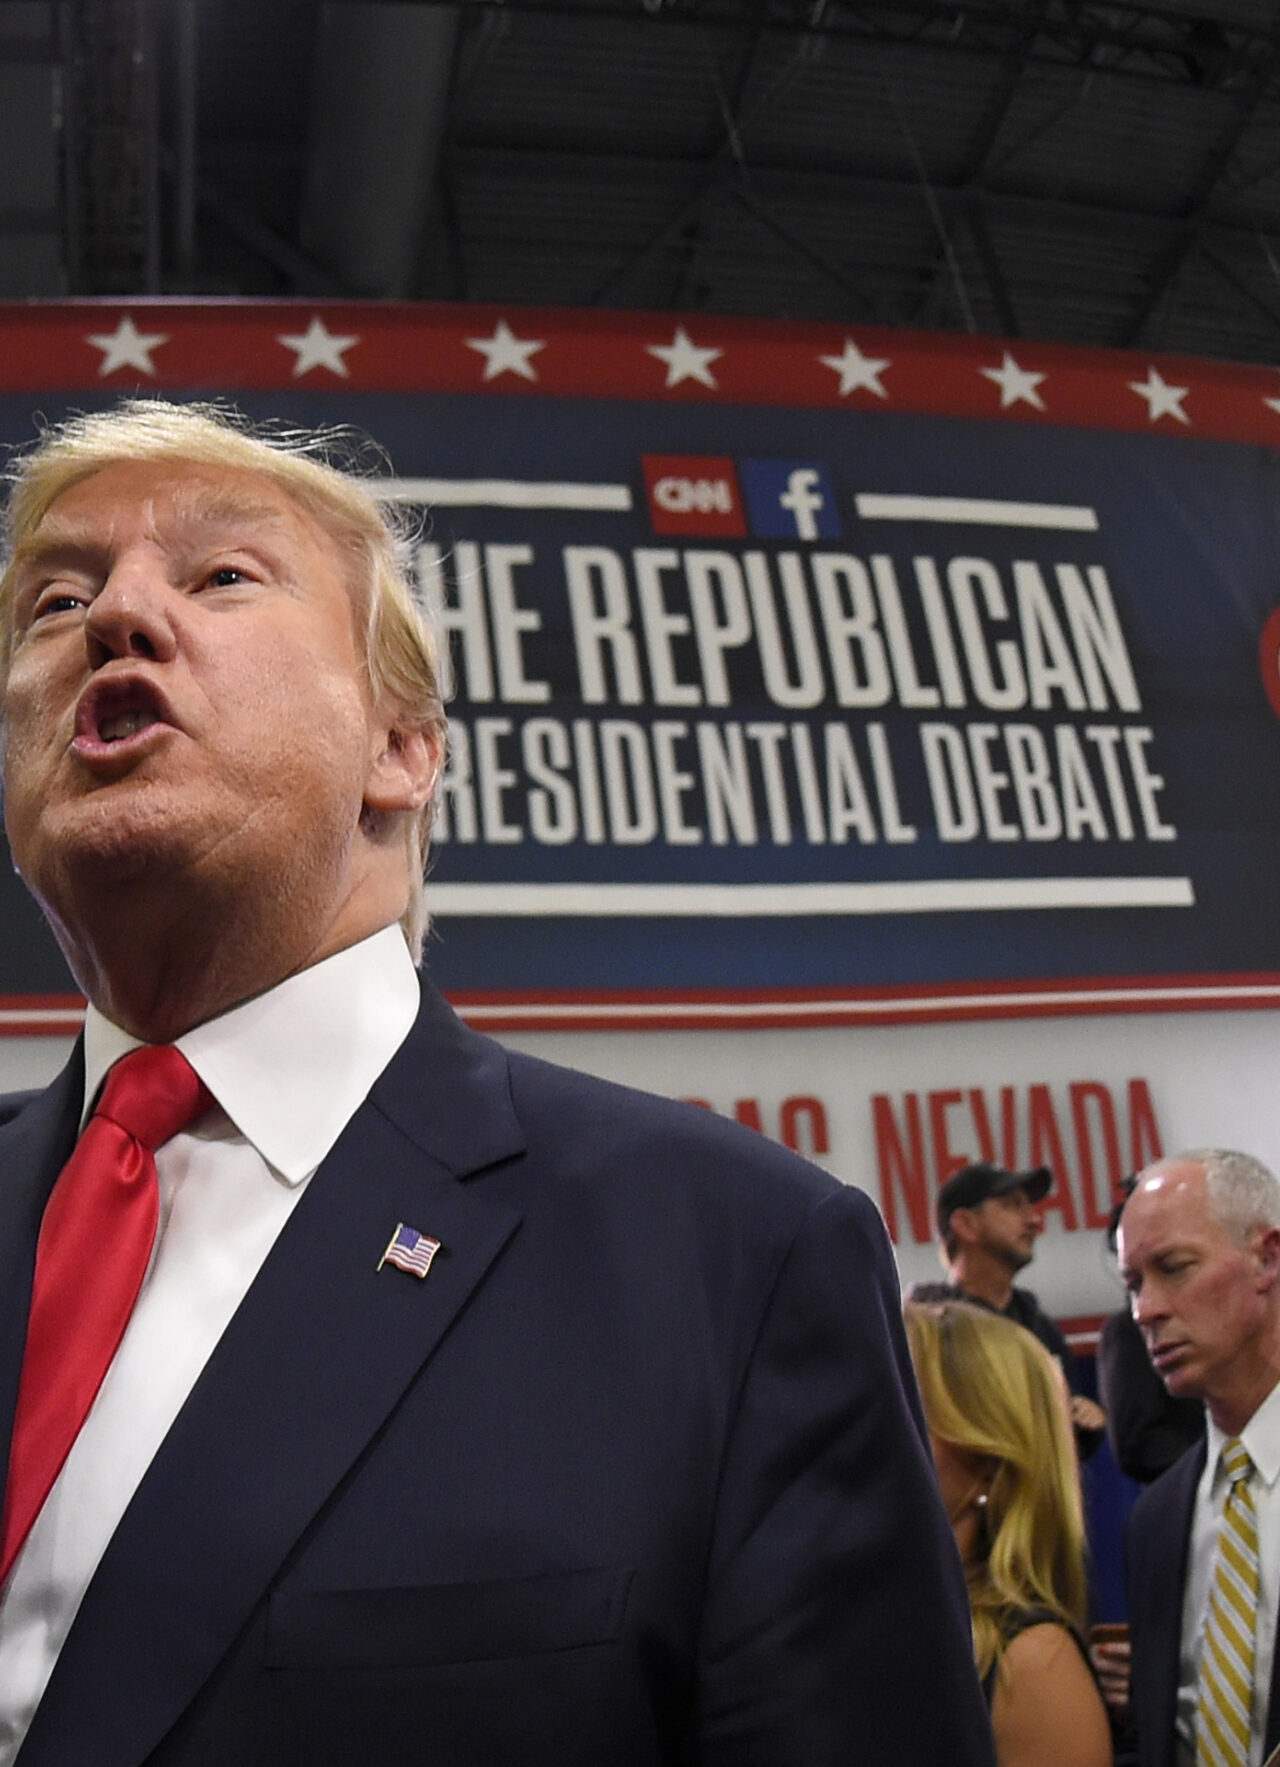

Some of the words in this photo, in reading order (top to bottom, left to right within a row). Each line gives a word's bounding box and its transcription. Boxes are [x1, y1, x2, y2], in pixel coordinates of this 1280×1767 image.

[654, 476, 733, 514] CNN
[422, 543, 551, 702] HE
[563, 547, 1142, 712] REPUBLICAN
[432, 716, 917, 845] RESIDENTIAL
[921, 723, 1177, 842] DEBATE
